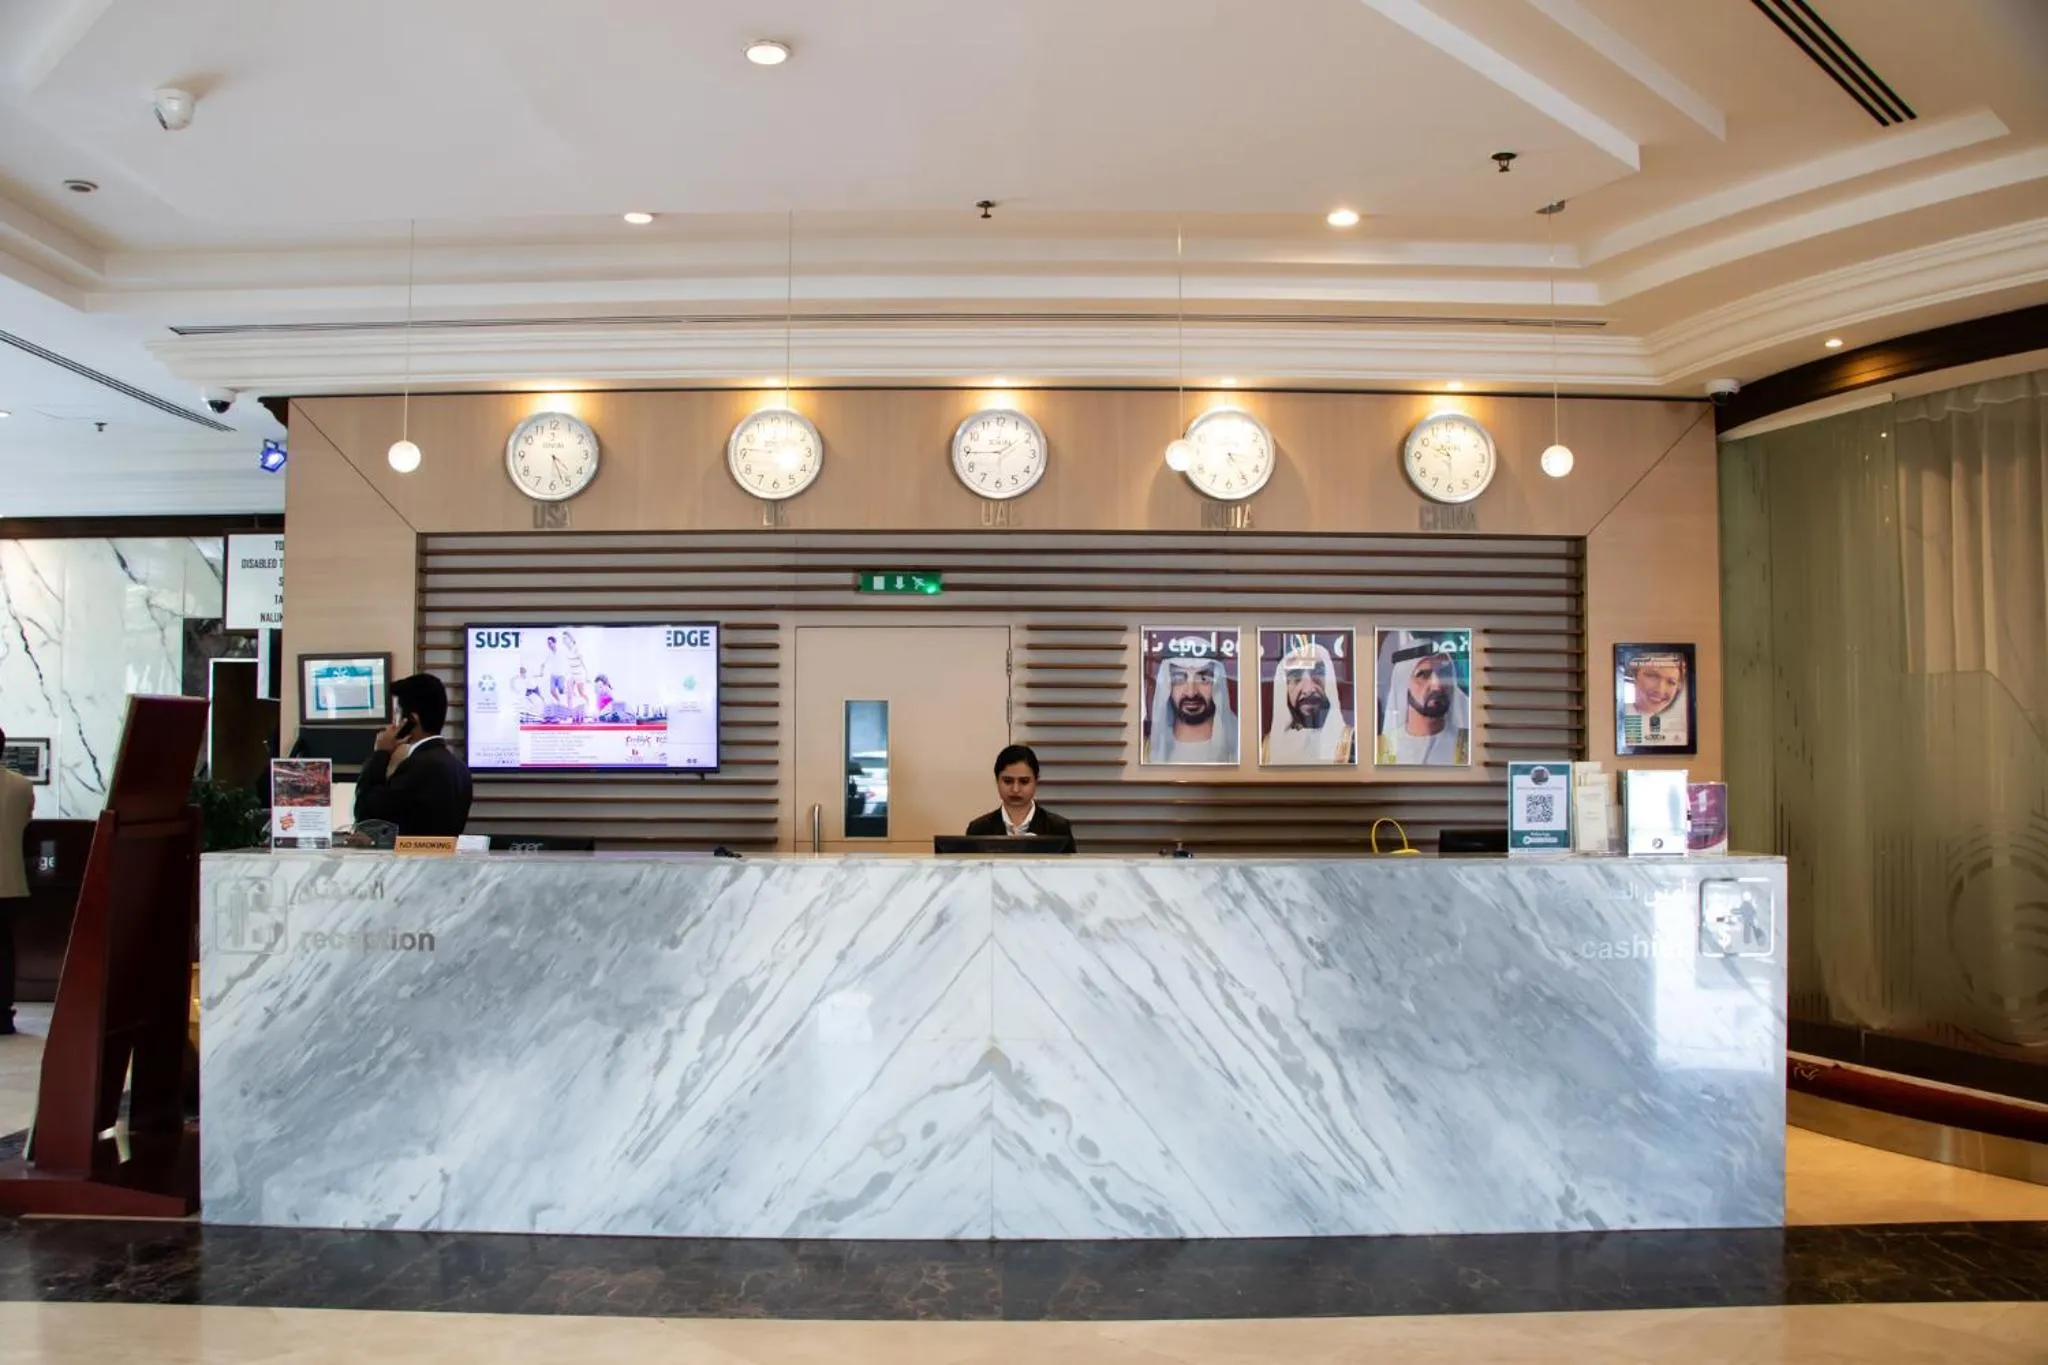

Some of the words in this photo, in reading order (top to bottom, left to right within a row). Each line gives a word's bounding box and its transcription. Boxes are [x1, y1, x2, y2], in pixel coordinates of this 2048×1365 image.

[533, 503, 571, 528] USA
[981, 501, 1019, 527] UAE
[1201, 502, 1256, 528] INDIA
[1419, 504, 1477, 530] CHINA
[241, 558, 277, 569] DISABLED
[476, 631, 520, 648] SUST
[414, 841, 453, 850] SMOKING
[299, 927, 435, 954] reception
